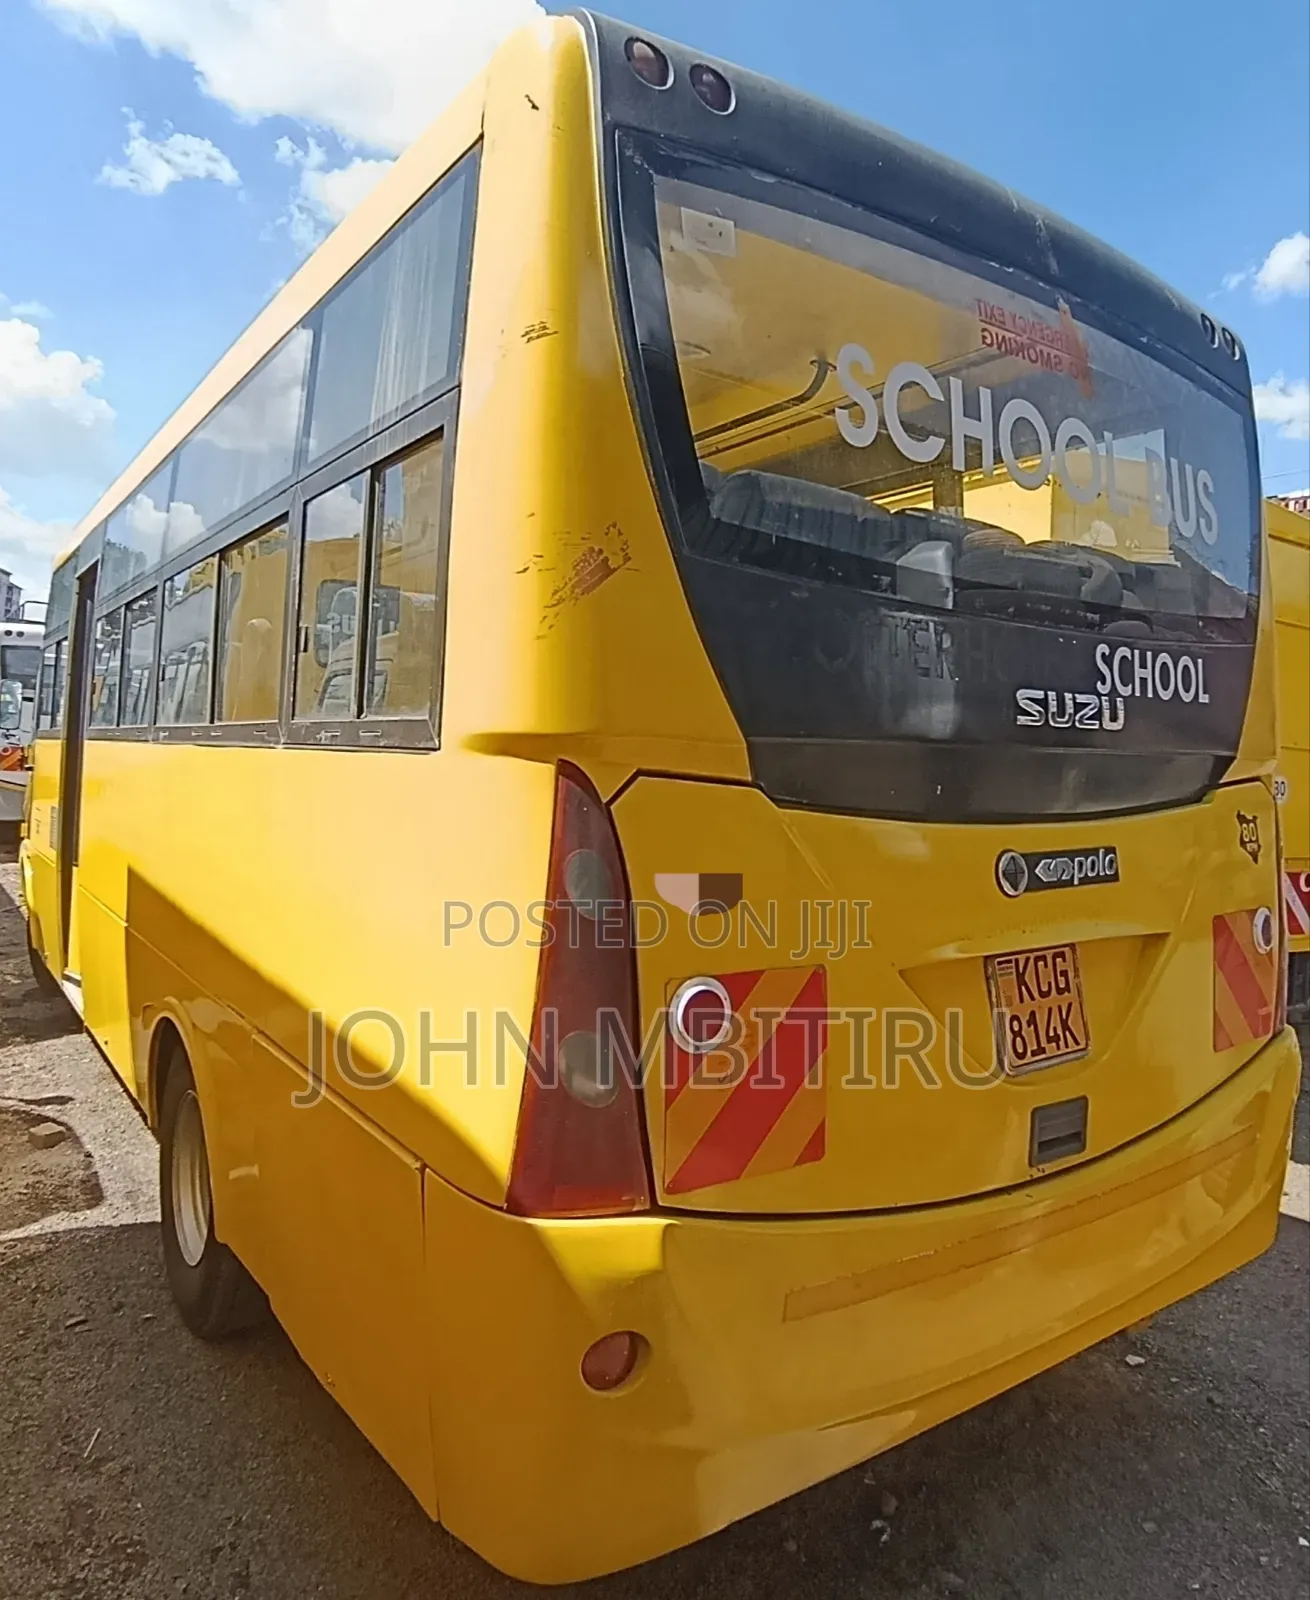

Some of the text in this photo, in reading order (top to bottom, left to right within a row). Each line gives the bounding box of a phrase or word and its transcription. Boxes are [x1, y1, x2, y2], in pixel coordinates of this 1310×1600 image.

[835, 343, 1219, 547] SCHOOL BUS
[1095, 643, 1210, 705] SCHOOL
[1015, 688, 1126, 731] SUZU
[1241, 822, 1257, 842] 80
[1014, 950, 1072, 1004] KCG
[1009, 1001, 1081, 1061] 814K
